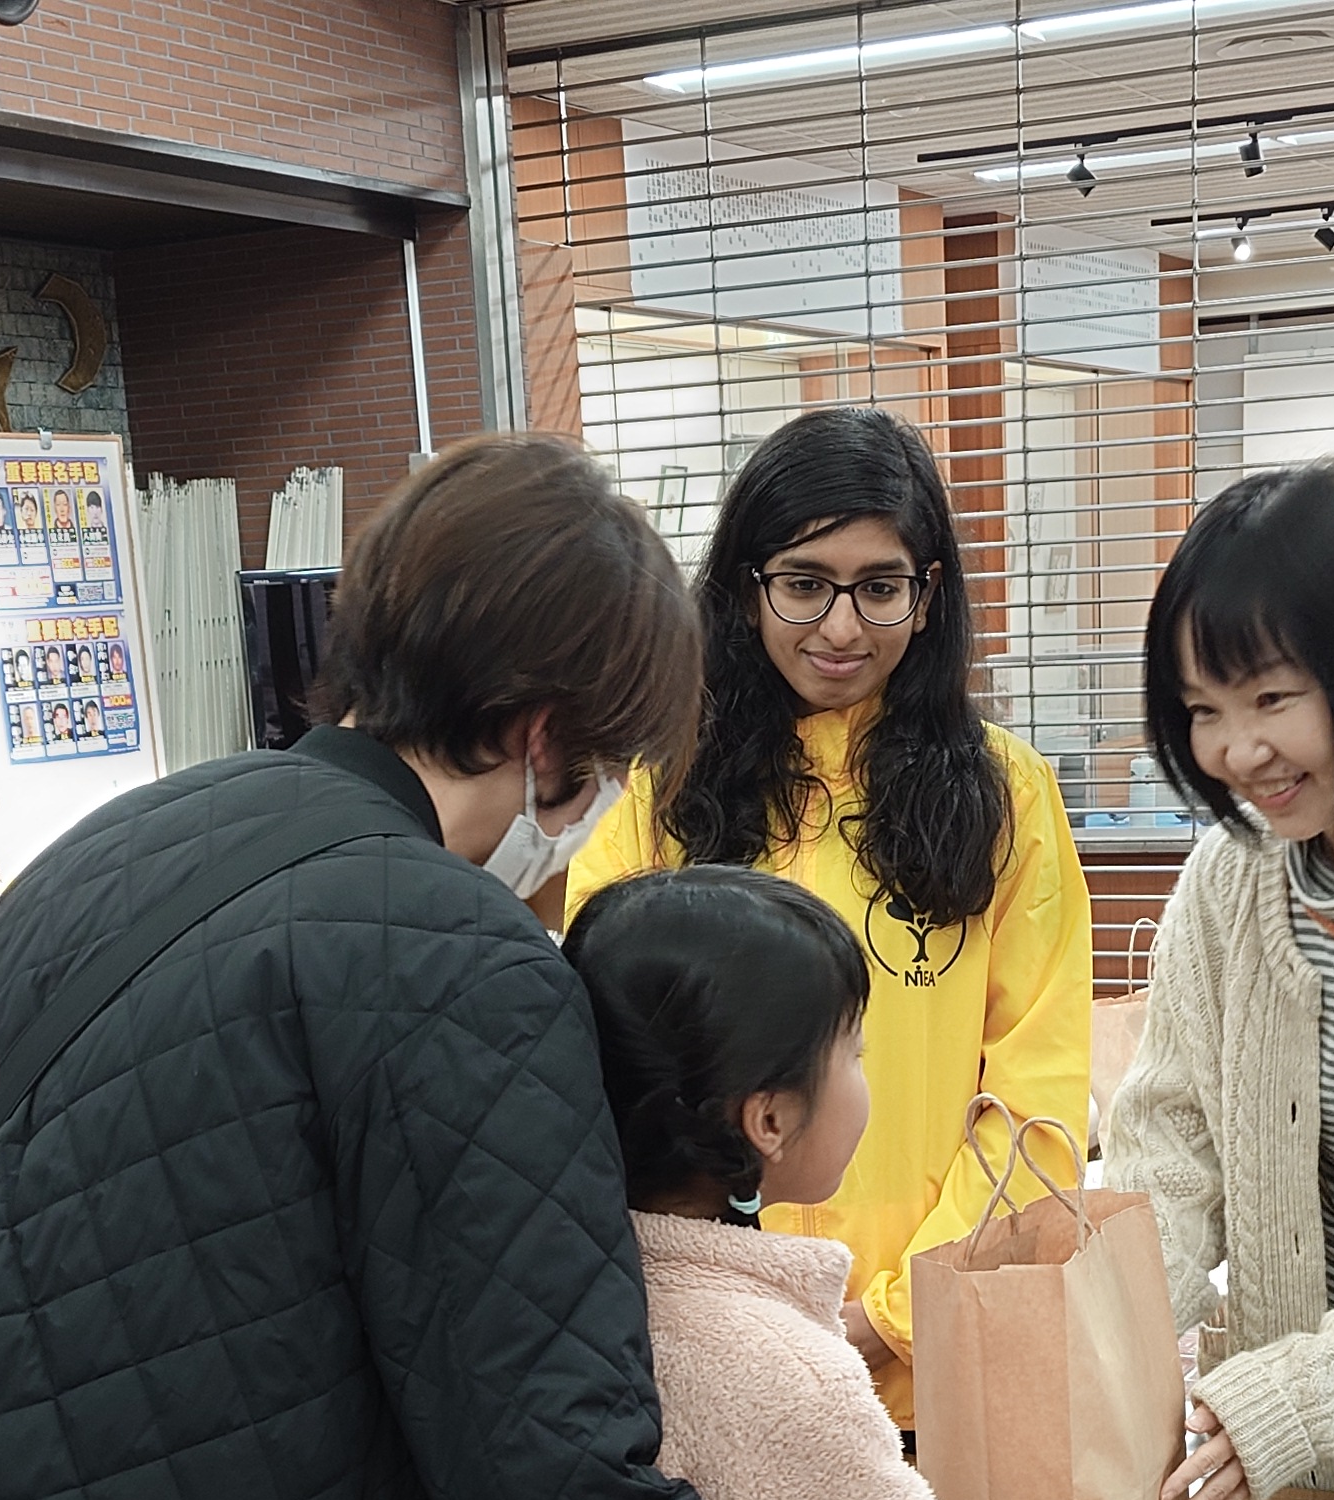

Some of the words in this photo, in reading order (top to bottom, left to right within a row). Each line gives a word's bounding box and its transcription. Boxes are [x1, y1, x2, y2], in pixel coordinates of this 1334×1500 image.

[4, 459, 101, 484] 重要指名手配
[25, 615, 120, 643] 重要指名手配
